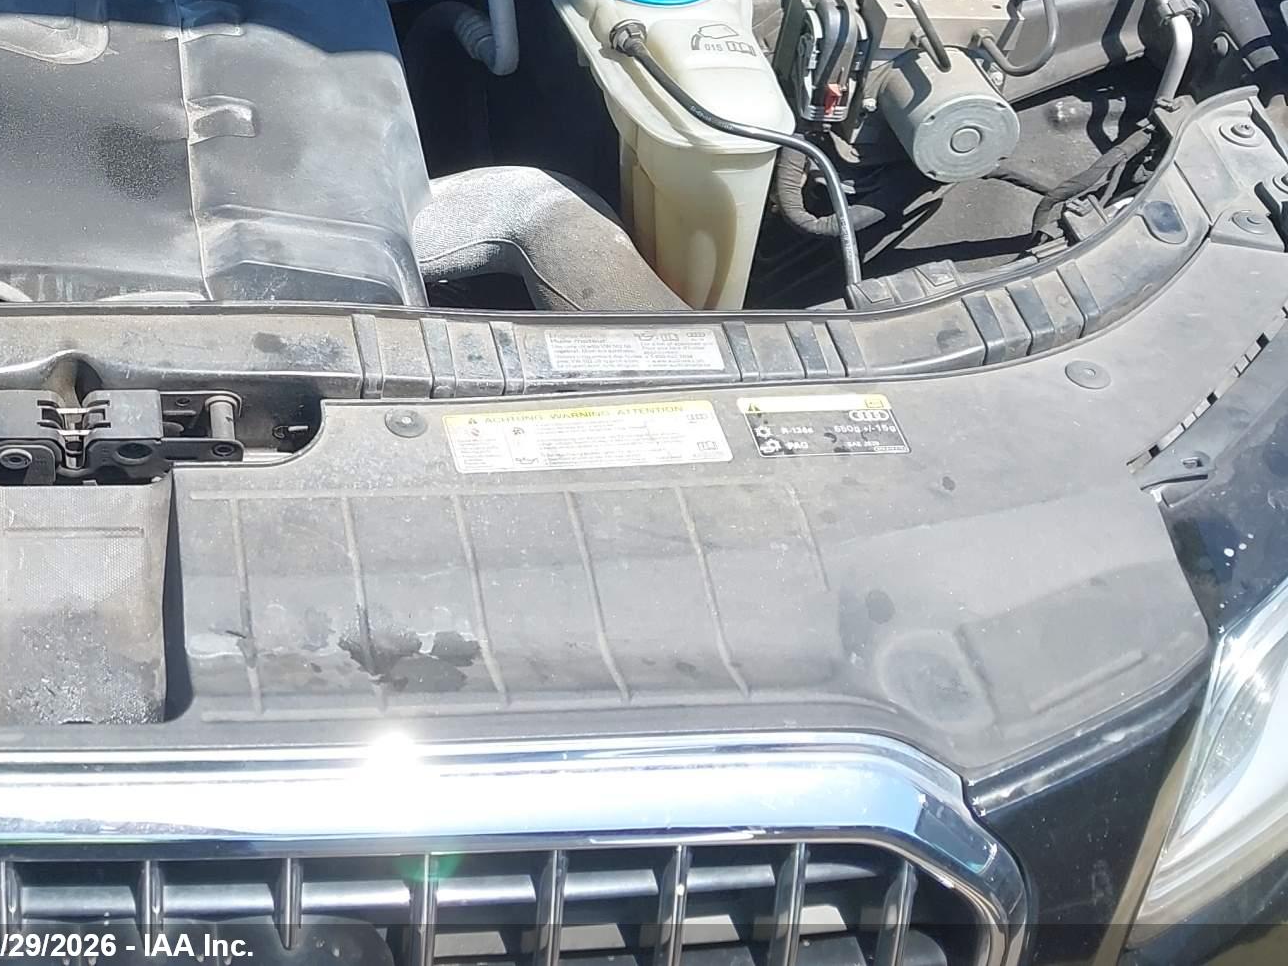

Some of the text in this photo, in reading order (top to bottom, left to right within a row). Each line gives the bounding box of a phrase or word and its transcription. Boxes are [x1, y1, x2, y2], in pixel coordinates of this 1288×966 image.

[484, 405, 683, 425] ACHTUNG WARNING ATTENTION
